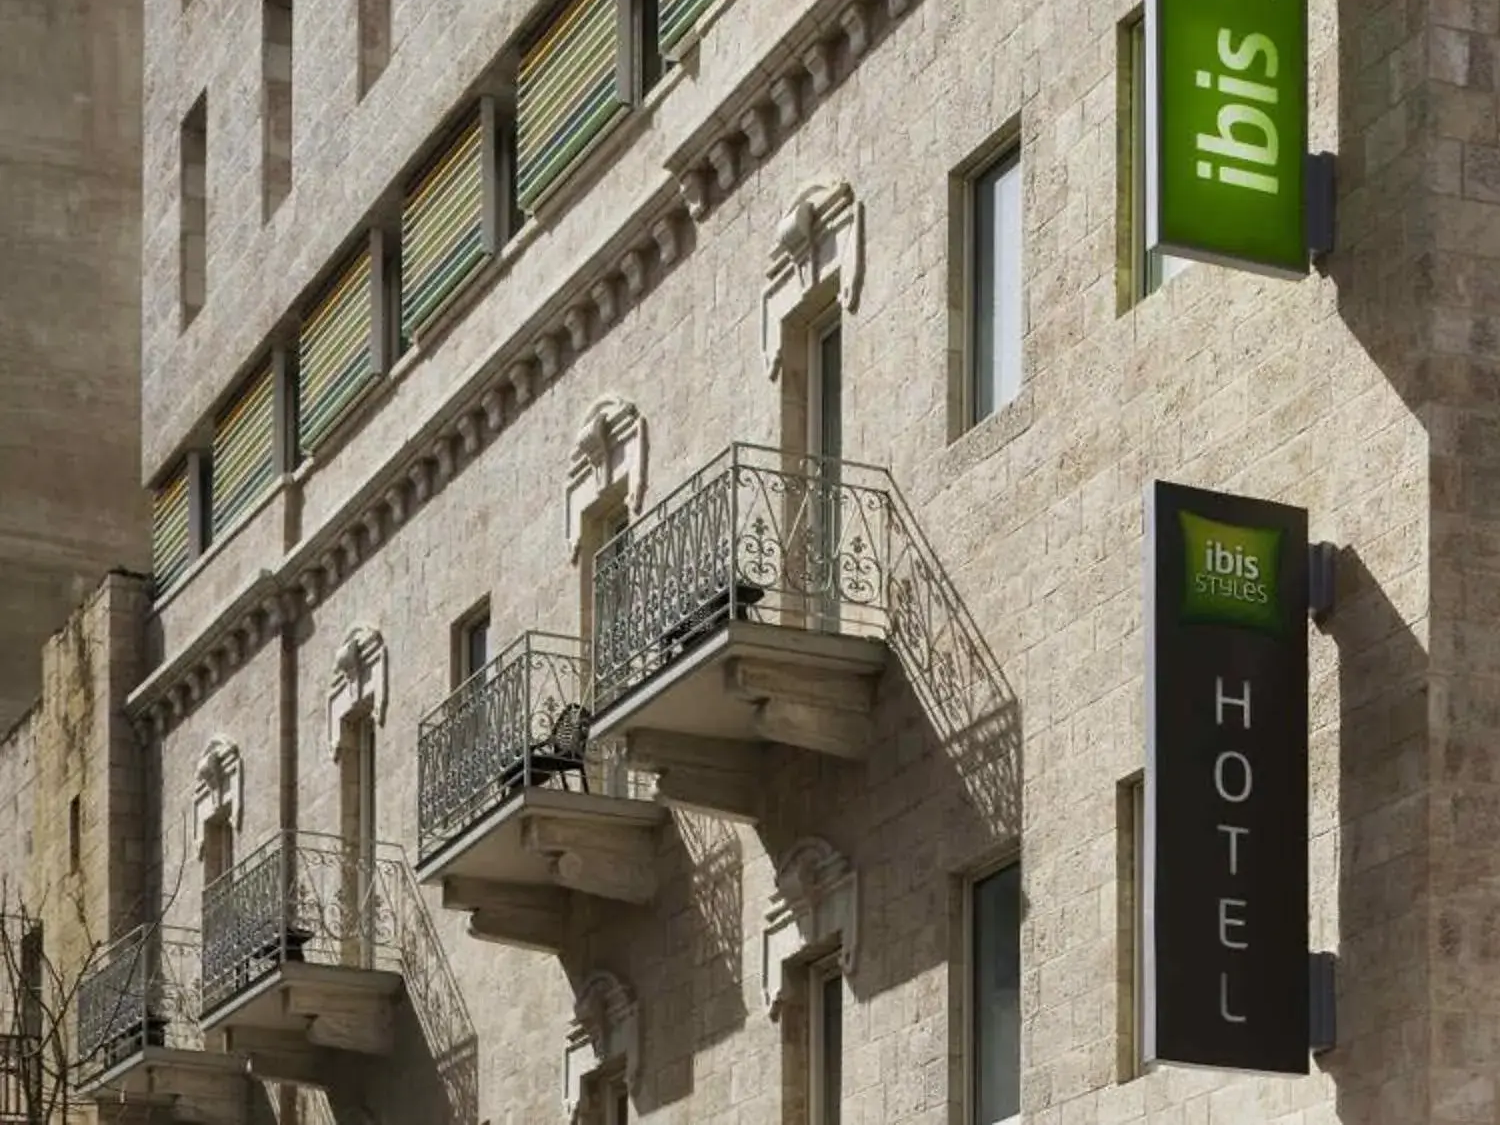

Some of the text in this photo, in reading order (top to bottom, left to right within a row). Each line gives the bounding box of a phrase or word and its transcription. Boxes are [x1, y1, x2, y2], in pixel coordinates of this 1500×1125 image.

[1196, 27, 1279, 194] ibis
[1205, 540, 1260, 580] ibis
[1214, 676, 1253, 1023] HOTEL
